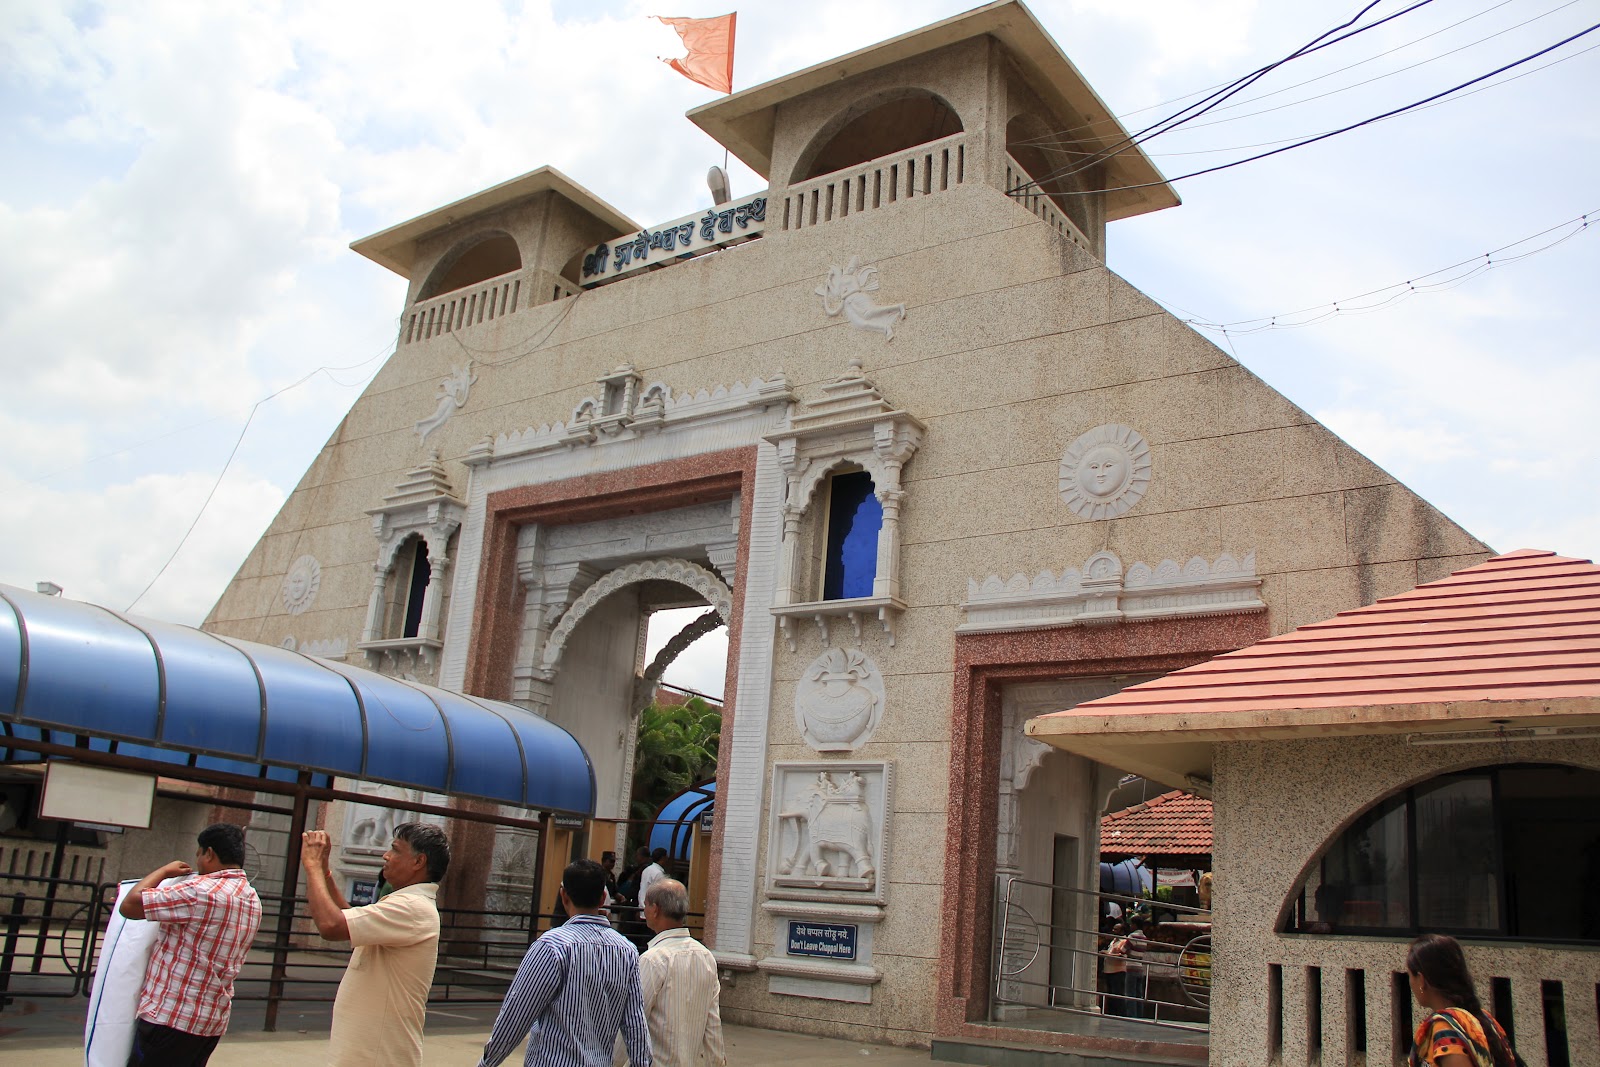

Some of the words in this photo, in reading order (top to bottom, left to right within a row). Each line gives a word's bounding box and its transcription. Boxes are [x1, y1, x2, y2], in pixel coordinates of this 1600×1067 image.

[583, 243, 609, 278] श्री
[790, 939, 803, 950] Don't
[804, 940, 818, 951] Leave
[819, 941, 838, 954] Chappal
[839, 943, 851, 954] Here
